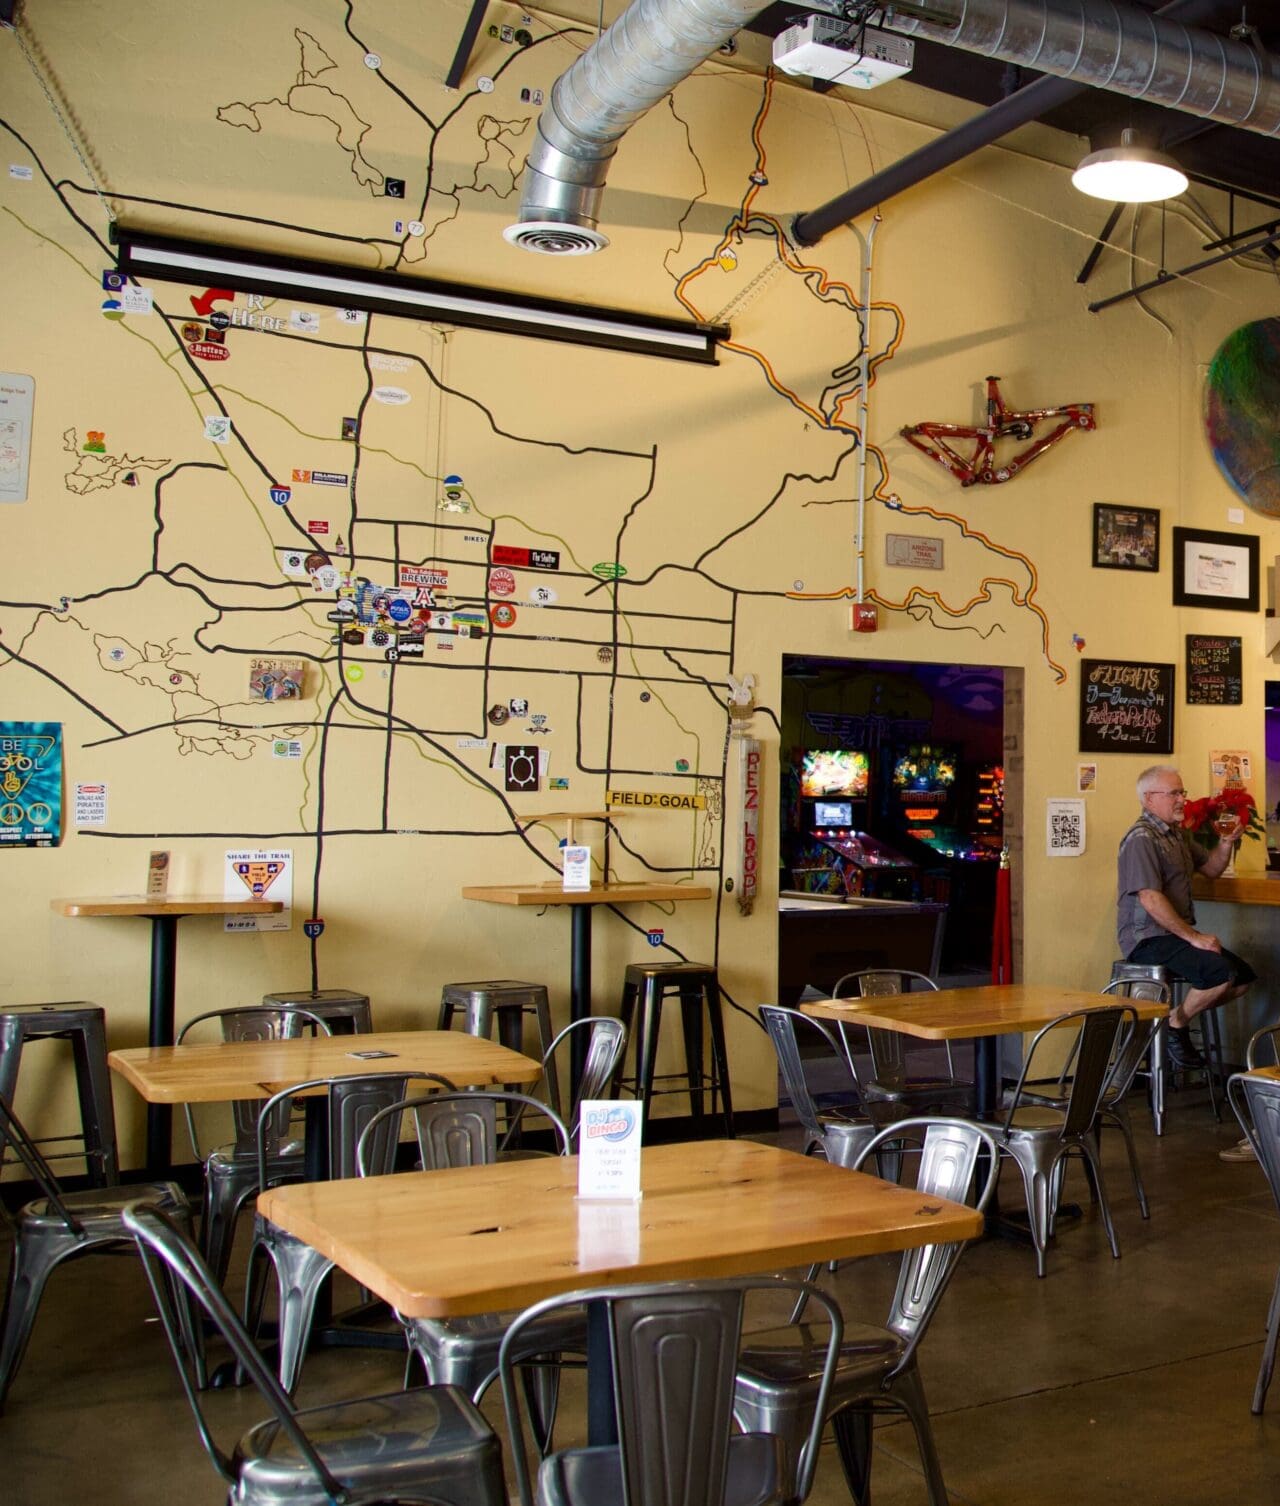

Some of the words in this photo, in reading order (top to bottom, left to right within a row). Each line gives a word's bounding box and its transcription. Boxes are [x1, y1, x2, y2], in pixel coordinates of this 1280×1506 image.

[231, 308, 287, 331] HERE
[273, 492, 288, 503] 10
[401, 573, 448, 585] BREWING
[2, 739, 23, 751] BE
[659, 794, 699, 809] GOAL
[308, 925, 320, 935] 19
[650, 933, 661, 945] 10
